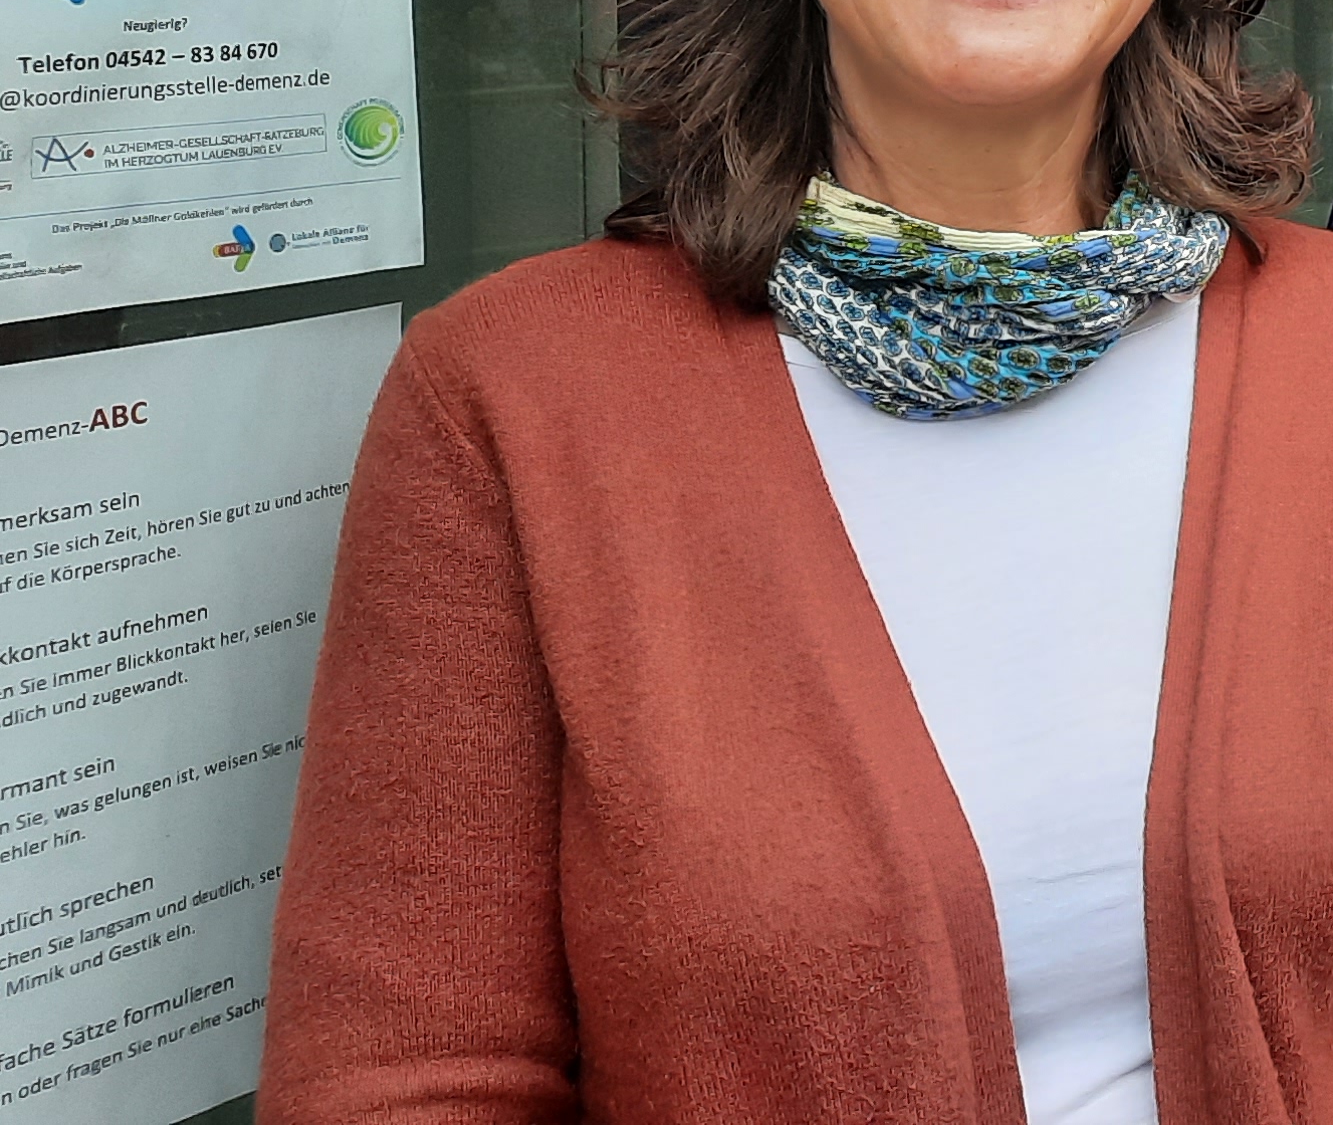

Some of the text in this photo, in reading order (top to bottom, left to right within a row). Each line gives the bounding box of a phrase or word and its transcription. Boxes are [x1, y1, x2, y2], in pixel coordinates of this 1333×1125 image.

[123, 17, 187, 33] Neugierig?
[17, 53, 99, 74] Telefon
[106, 49, 166, 69] 04542
[191, 47, 214, 64] 83
[220, 45, 242, 62] 84
[247, 42, 278, 60] 670
[0, 70, 330, 111] @koordinierungsstelle-demenz.de
[122, 152, 198, 167] HERZOGTUM
[202, 146, 266, 161] LAUENBURG
[34, 540, 60, 559] Sie
[66, 532, 99, 553] sich
[105, 526, 142, 546] Zeit,
[147, 515, 194, 536] hören
[199, 509, 222, 526] Sie
[226, 503, 251, 523] gut
[255, 499, 270, 513] zu
[276, 489, 301, 509] und
[305, 480, 351, 502] achten
[99, 491, 140, 512] sein
[16, 570, 45, 590] die
[51, 544, 181, 584] Körpersprache.
[98, 605, 208, 645] aufnehmen
[20, 678, 48, 695] Sie
[53, 662, 112, 688] immer
[116, 637, 215, 672] Blickkontakt
[220, 628, 250, 649] her,
[254, 616, 292, 638] seien
[296, 610, 317, 626] Sie
[2, 670, 189, 728] dlich und zugewandt.
[1, 757, 115, 802] rmant sein
[15, 810, 48, 831] Sie,
[54, 798, 89, 820] was
[94, 776, 172, 812] gelungen
[177, 767, 200, 786] ist,
[204, 751, 258, 776] weisen
[261, 742, 282, 760] Sie
[1, 828, 86, 863] ehler hin.
[48, 936, 74, 954] Sie
[80, 911, 151, 945] langsam
[156, 895, 187, 918] und
[193, 875, 255, 907] deutlich,
[59, 875, 154, 918] sprechen
[6, 923, 196, 998] Mimik und Gestik ein.
[62, 1018, 117, 1051] Sätze
[124, 975, 235, 1028] formulieren
[19, 1073, 62, 1100] oder
[66, 1051, 123, 1083] fragen
[127, 1040, 152, 1059] Sie
[158, 1028, 186, 1048] nur
[190, 1014, 221, 1035] eine
